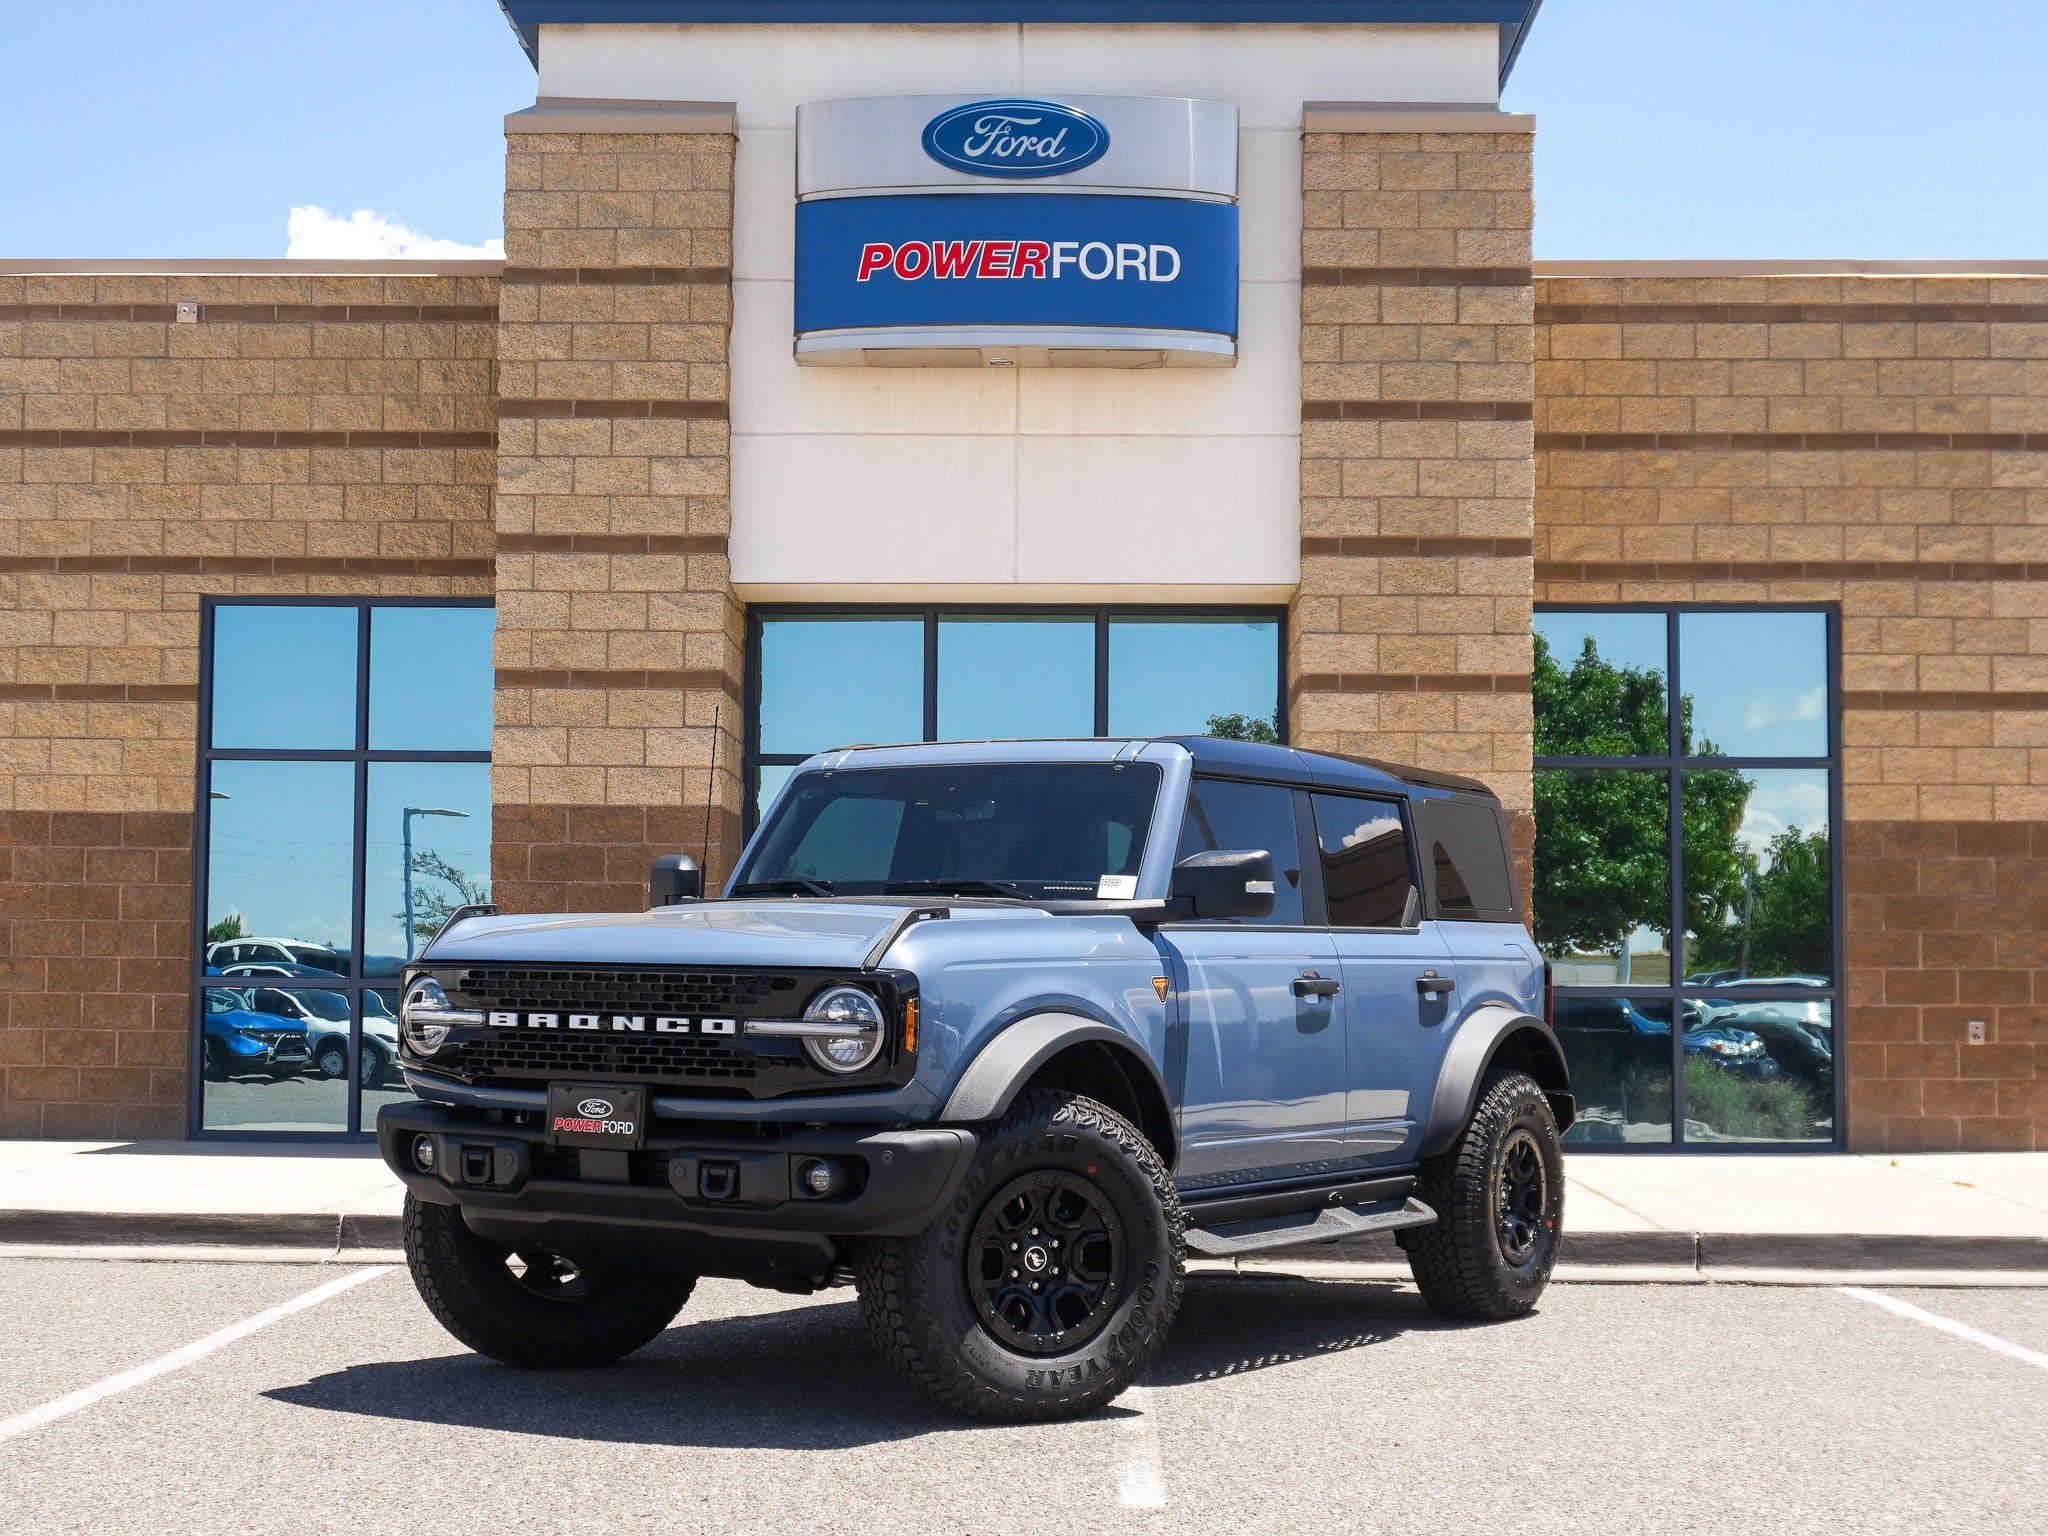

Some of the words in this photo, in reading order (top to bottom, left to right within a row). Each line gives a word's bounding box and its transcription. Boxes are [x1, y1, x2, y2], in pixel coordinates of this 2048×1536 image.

[964, 115, 1067, 158] Ford
[488, 1011, 736, 1034] BRONCO
[584, 1101, 607, 1114] Ford
[1118, 1261, 1161, 1346] GOOD
[1025, 1356, 1103, 1389] YEAR
